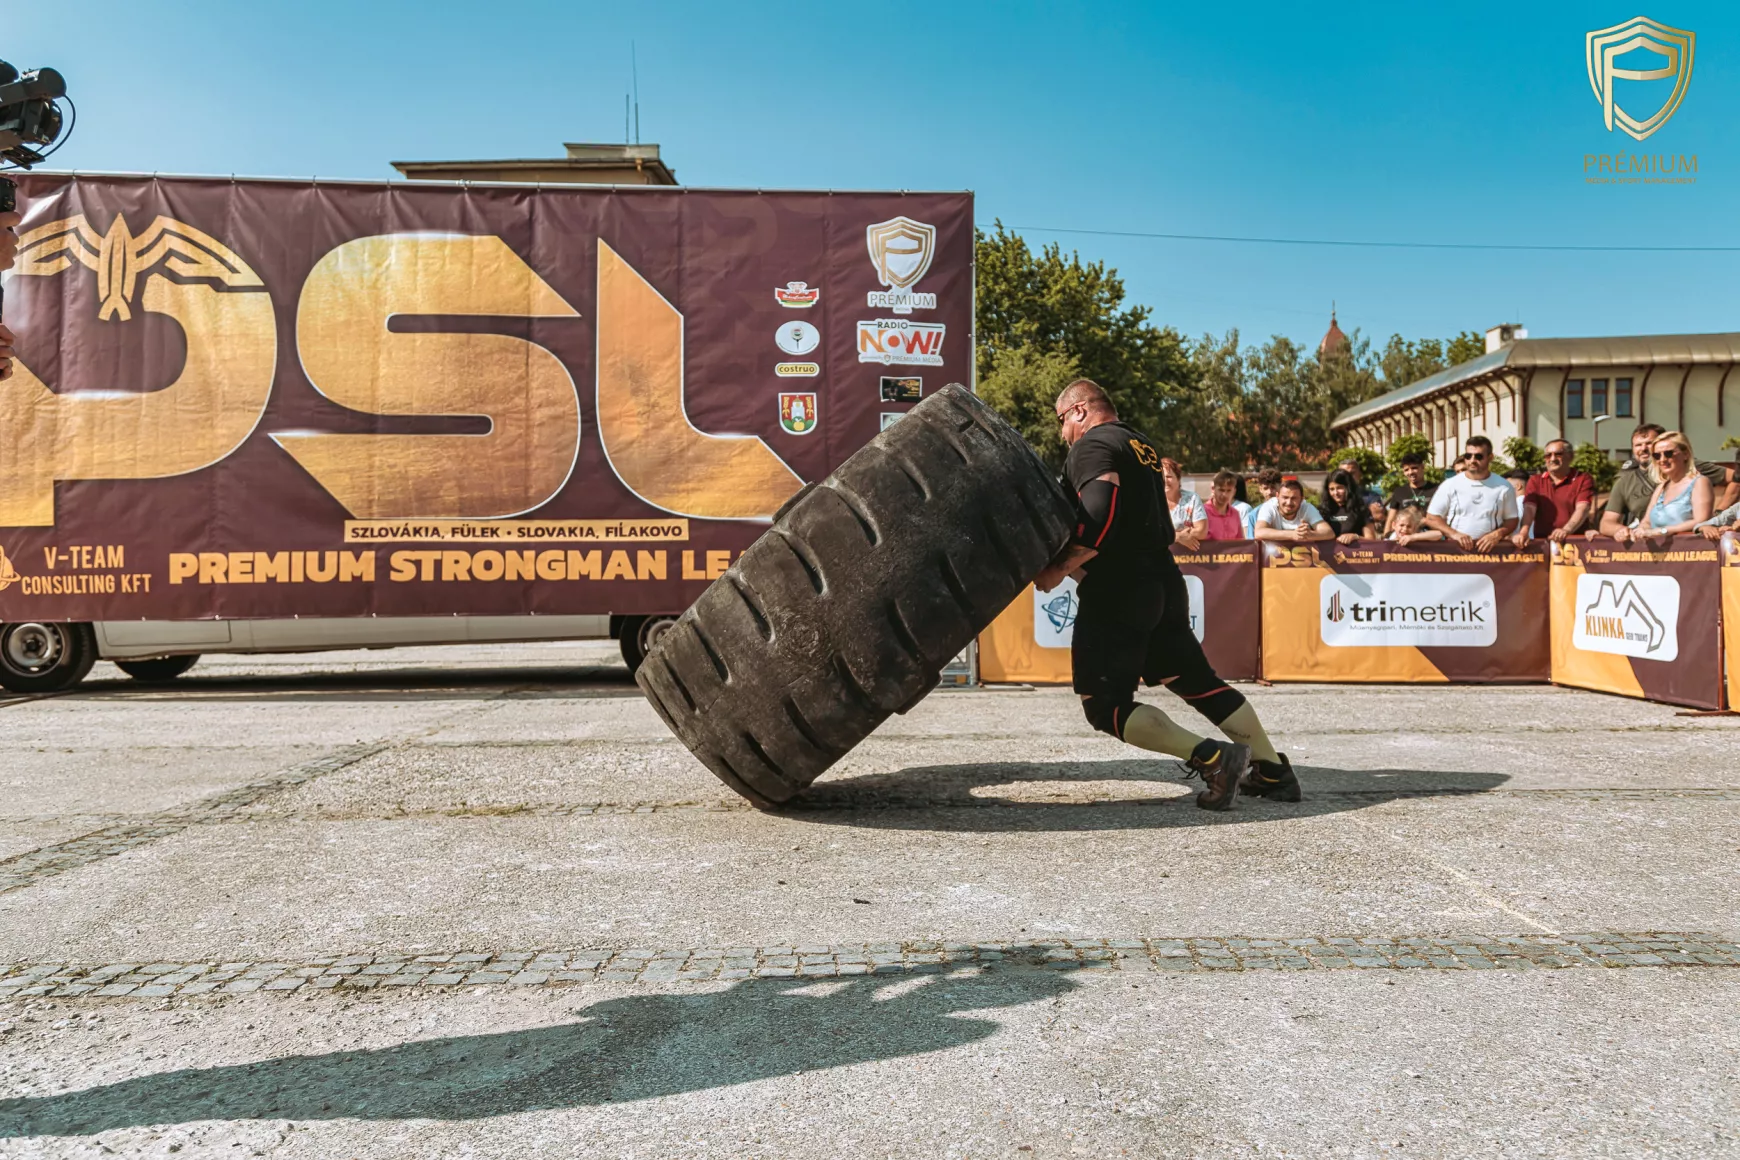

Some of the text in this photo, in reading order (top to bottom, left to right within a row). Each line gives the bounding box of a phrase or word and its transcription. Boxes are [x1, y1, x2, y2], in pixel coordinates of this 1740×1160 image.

[869, 291, 935, 307] PRÉMIUM
[877, 321, 909, 330] RADIO
[778, 364, 816, 374] costruo
[350, 522, 446, 541] SZLOVÁKIA,
[450, 523, 501, 539] FÜLEK
[516, 526, 601, 540] SLOVAKIA,
[43, 544, 126, 570] V-TEAM
[1212, 553, 1254, 564] LEAGUE
[1383, 552, 1545, 564] PREMIUM STRONGMAN LEAGUE
[168, 549, 750, 586] PREMIUM STRONGMAN LE
[21, 573, 152, 596] CONSULTING KFT
[1585, 614, 1625, 640] KLINKA
